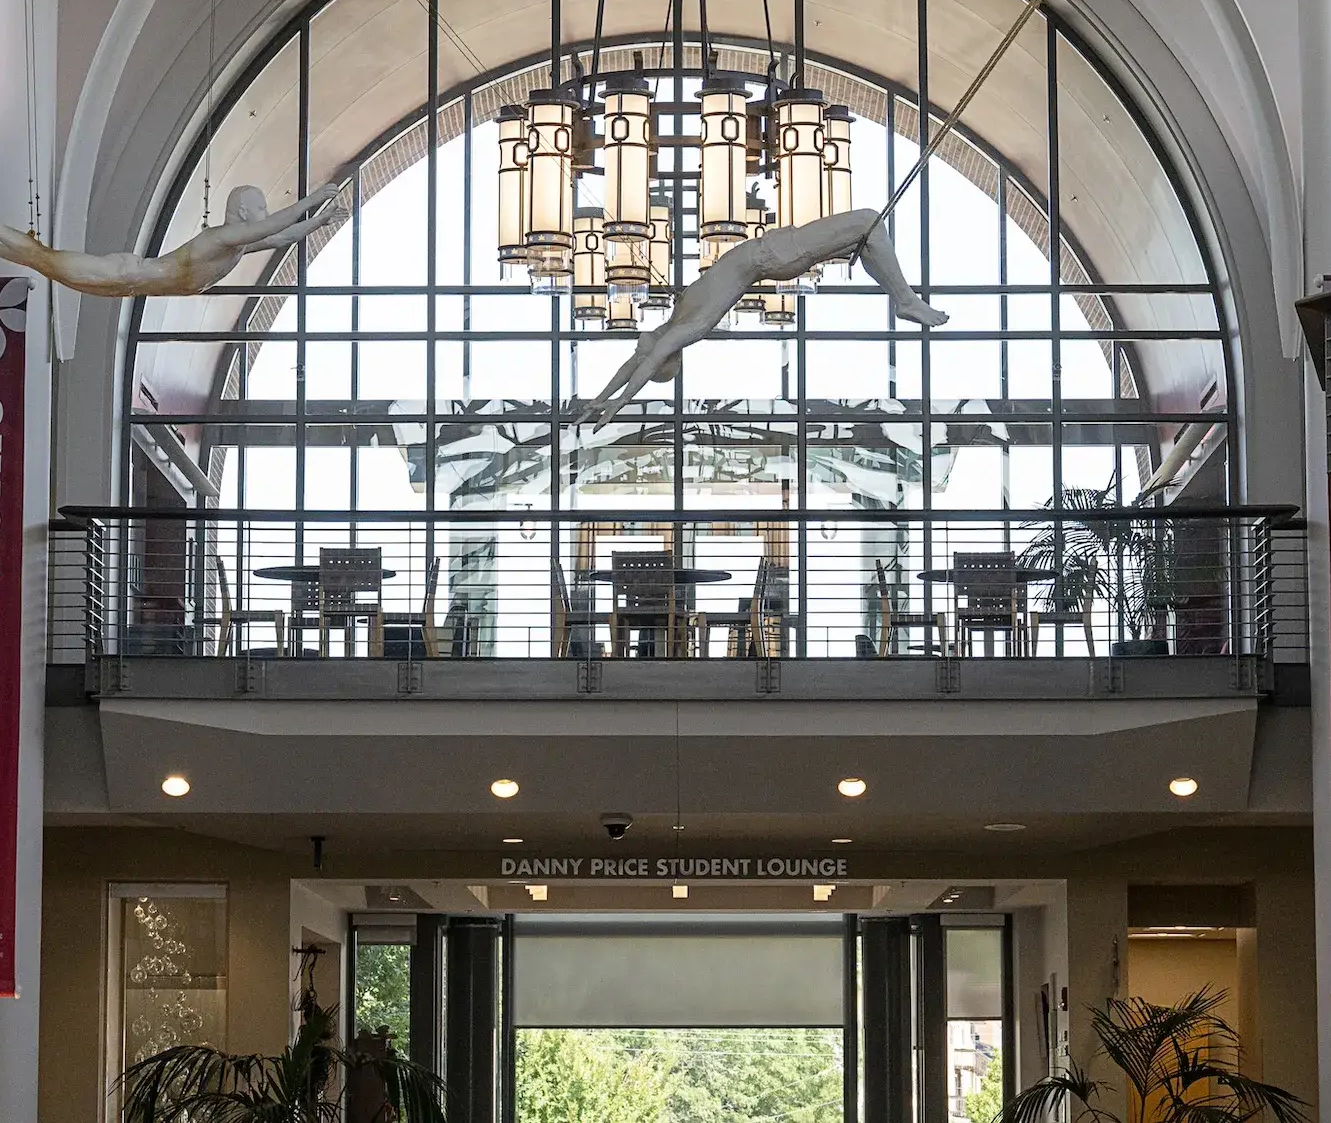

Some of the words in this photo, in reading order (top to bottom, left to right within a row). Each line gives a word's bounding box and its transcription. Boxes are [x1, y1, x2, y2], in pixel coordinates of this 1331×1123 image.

[501, 858, 584, 876] DANNY
[590, 858, 648, 876] PRICE
[656, 858, 751, 876] STUDENT
[757, 858, 848, 876] LOUNGE
